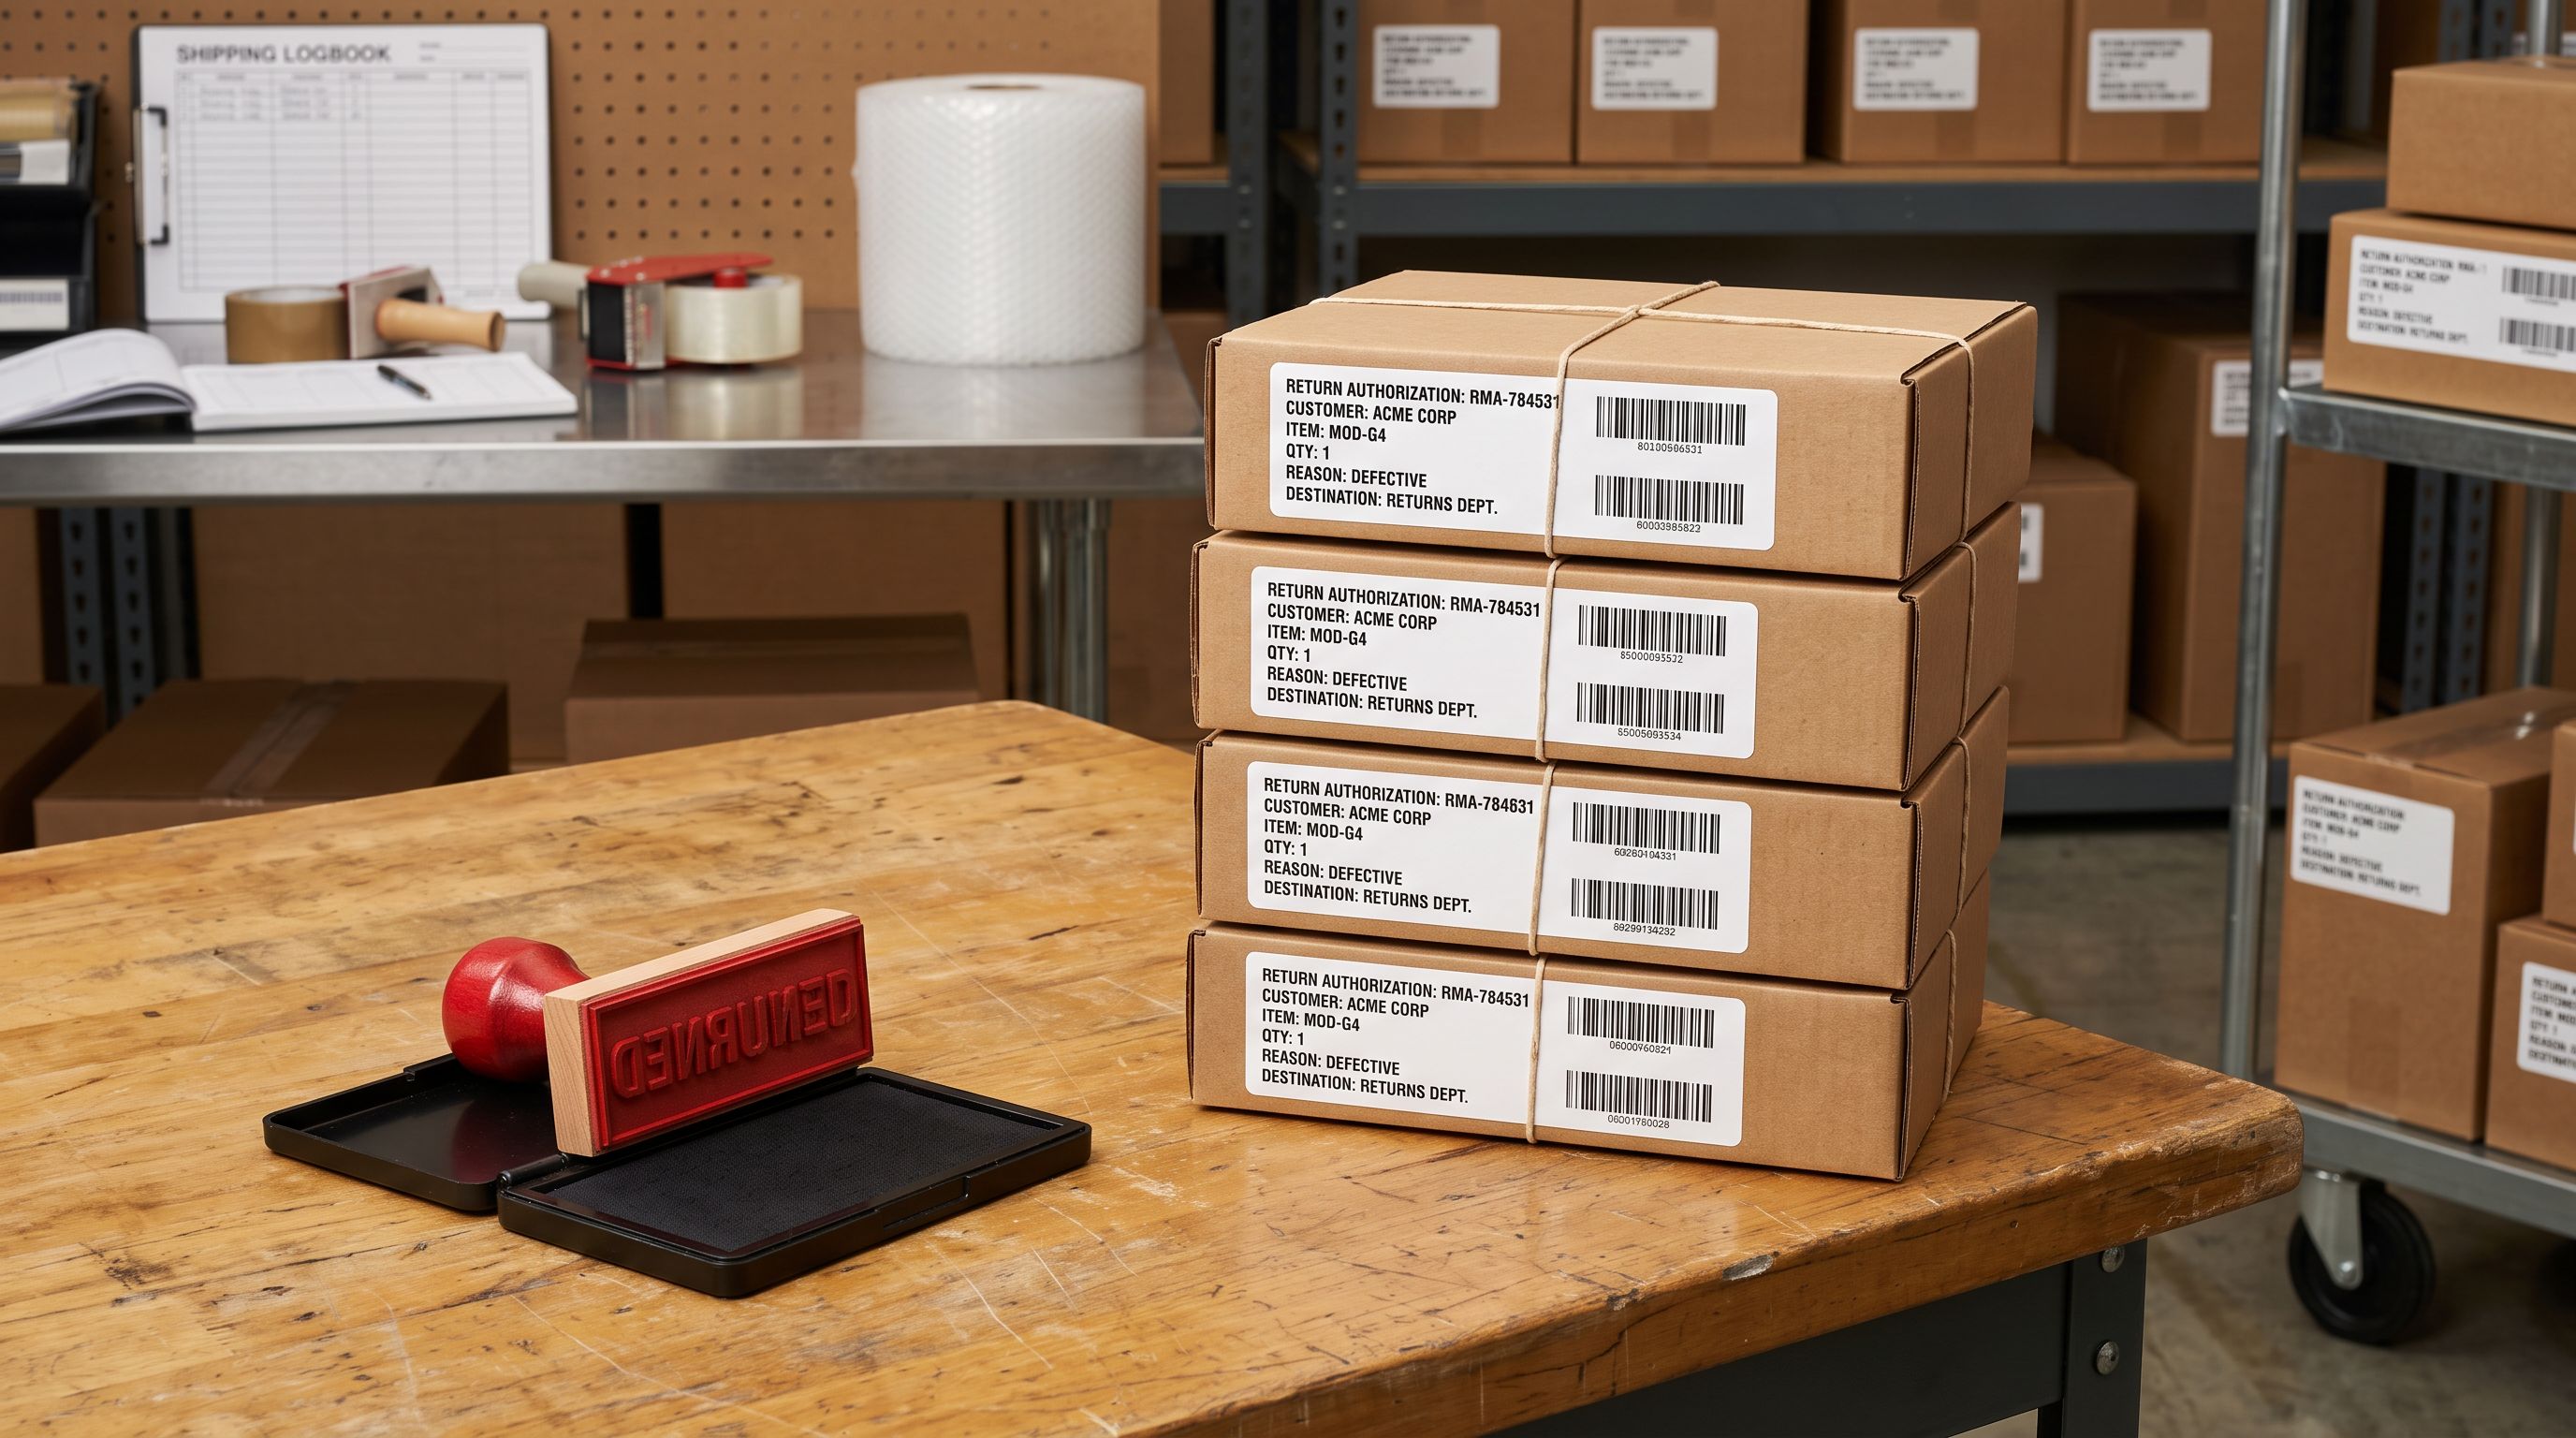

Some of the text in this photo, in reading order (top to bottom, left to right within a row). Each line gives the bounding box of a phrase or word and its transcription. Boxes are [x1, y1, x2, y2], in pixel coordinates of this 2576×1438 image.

[177, 45, 391, 64] SHIPPING LOGBOOK
[1286, 378, 1559, 410] RETURN AUTHORIZATION: RMA-784531
[1286, 400, 1456, 425] CUSTOMER: ACME CORP
[1286, 421, 1386, 443] ITEM: MOD-G4
[1286, 443, 1329, 461] QTY: 1
[1286, 464, 1427, 489] REASON: DEFECTIVE
[1286, 486, 1498, 515] DESTINATION: RETURNS DEPT.
[1267, 581, 1540, 618] RETURN AUTHORIZATION: RMA-784531
[1267, 603, 1438, 631] CUSTOMER: ACME CORP
[1267, 624, 1368, 646] ITEM: MOD-G4
[1267, 644, 1310, 663] QTY: 1
[1267, 666, 1408, 692] REASON: DEFECTIVE
[1267, 686, 1477, 719] DESTINATION: RETURNS DEPT.
[1264, 777, 1533, 814] RETURN AUTHORIZATION: RMA-784631
[1264, 798, 1431, 826] CUSTOMER: ACME CORP
[1265, 818, 1364, 841] ITEM: MOD-G4
[1264, 839, 1307, 857] QTY: 1
[1264, 859, 1402, 886] REASON: DEFECTIVE
[1265, 879, 1471, 914] DESTINATION: RETURNS DEPT.
[1263, 967, 1529, 1007] RETURN AUTHORIZATION: RMA-784531
[1262, 988, 1429, 1018] CUSTOMER: ACME CORP
[1262, 1007, 1360, 1032] ITEM: MOD-G4
[1262, 1028, 1304, 1046] QTY: 1
[1262, 1048, 1400, 1076] REASON: DEFECTIVE
[1262, 1068, 1469, 1104] DESTINATION: RETURNS DEPT.
